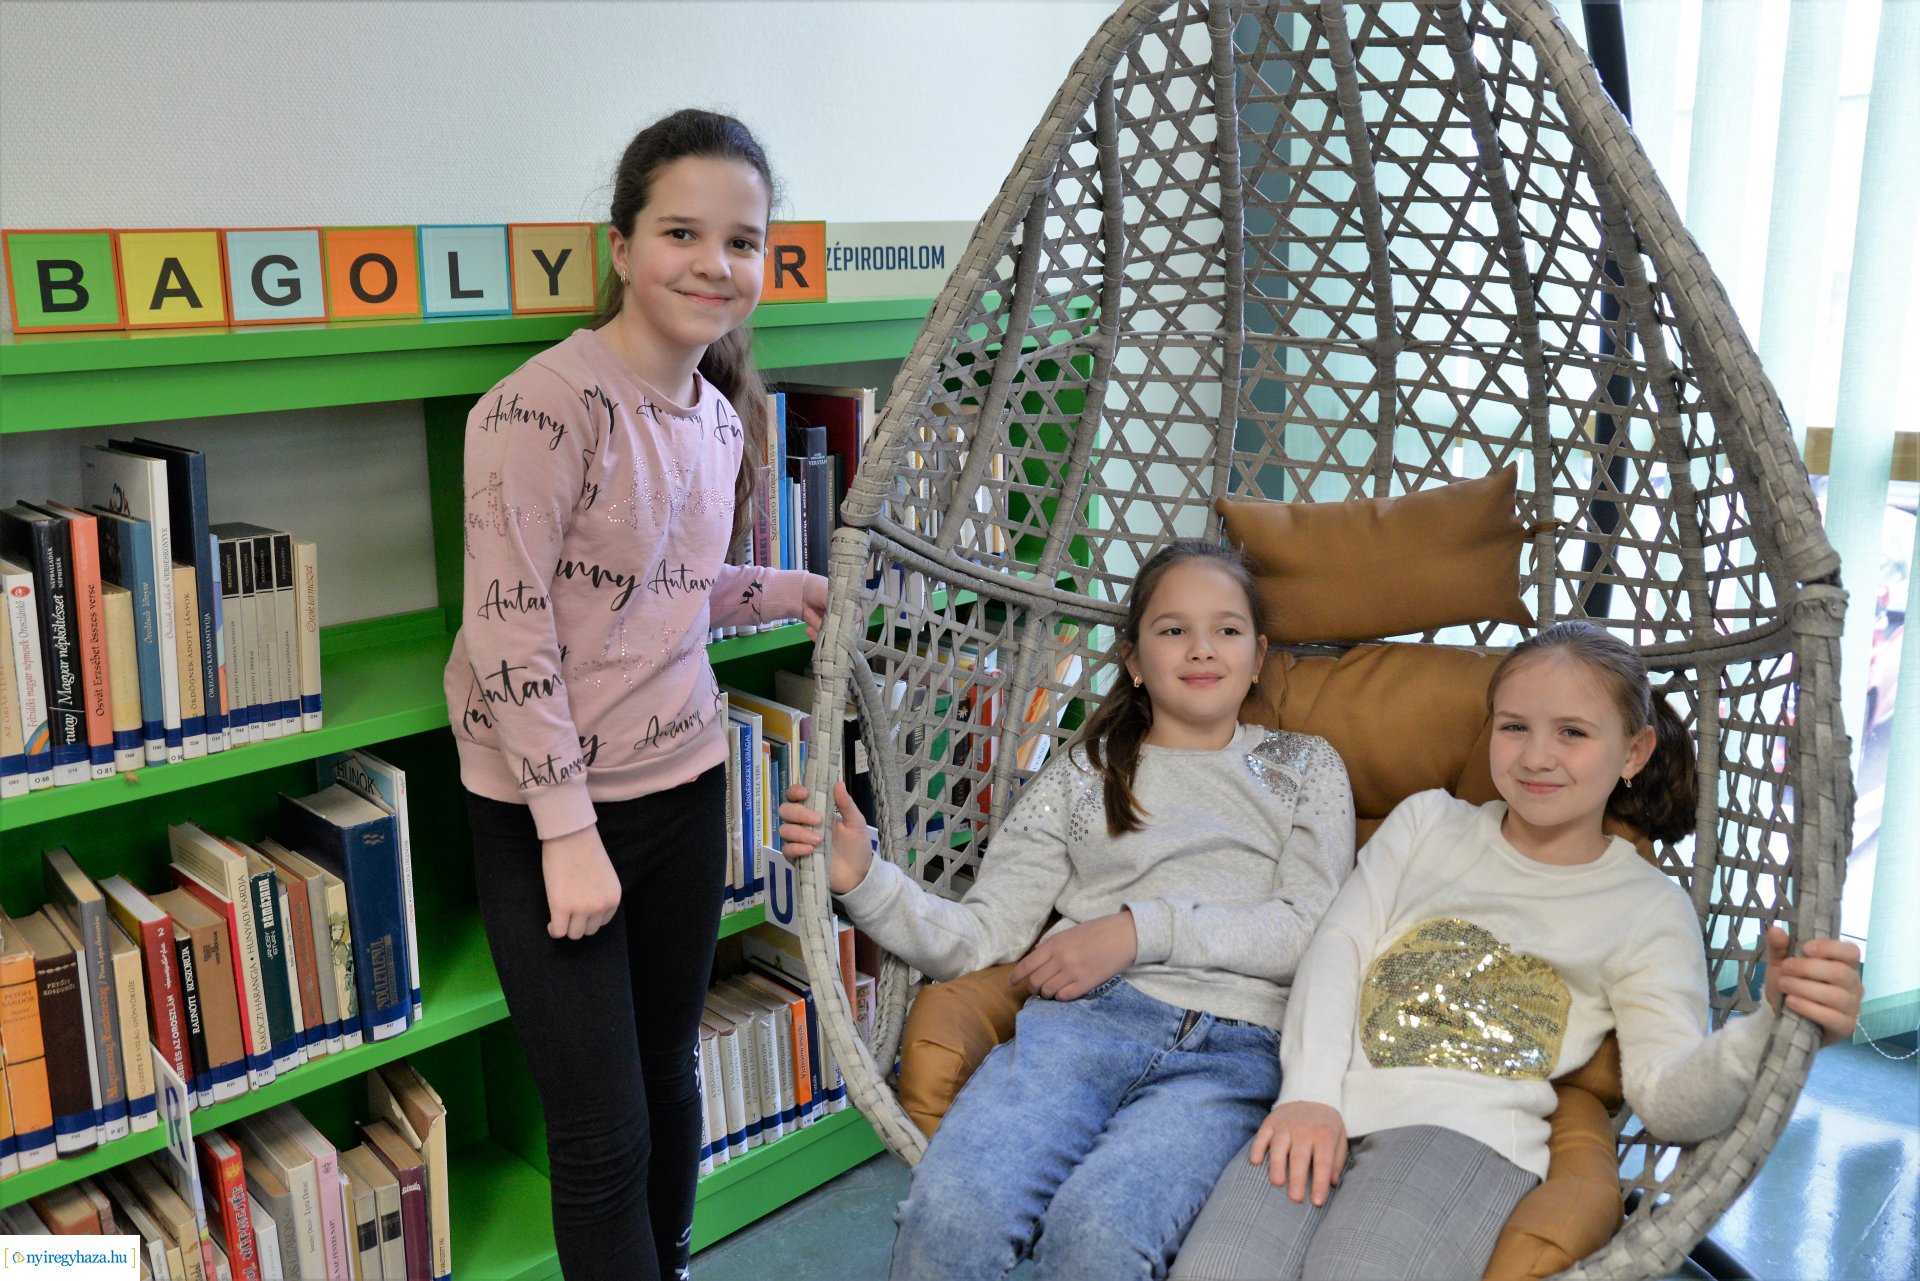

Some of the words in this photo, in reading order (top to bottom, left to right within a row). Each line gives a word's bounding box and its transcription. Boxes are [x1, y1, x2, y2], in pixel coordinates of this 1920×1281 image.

[826, 241, 946, 271] ZÉPIRODALOM
[87, 584, 98, 610] verse
[183, 592, 192, 627] LÁNYOK
[52, 594, 72, 657] népköltészet
[89, 612, 100, 643] összes
[204, 612, 213, 664] KARMANTYÚJA
[20, 639, 34, 671] népmesék
[186, 629, 194, 658] ADOTT
[57, 656, 74, 705] Magyar
[89, 644, 104, 685] Erzsébet
[25, 672, 38, 697] magyar
[94, 687, 105, 716] Osvát
[187, 660, 198, 710] ÖRDÖGNEK
[63, 713, 78, 745] rtutay
[237, 874, 252, 909] KARDJA
[769, 861, 794, 925] U
[158, 928, 165, 937] 2
[243, 910, 255, 954] HUNYADI
[181, 946, 195, 991] KOSZORÚJA
[249, 962, 263, 1011] HARANGJA
[166, 995, 180, 1039] OROSZLÁN
[187, 996, 201, 1034] RADNÓTI
[257, 1012, 268, 1051] RÁKÓCZI
[171, 1039, 181, 1049] AZ
[172, 1050, 183, 1060] ÉS
[177, 1061, 186, 1083] ABBI
